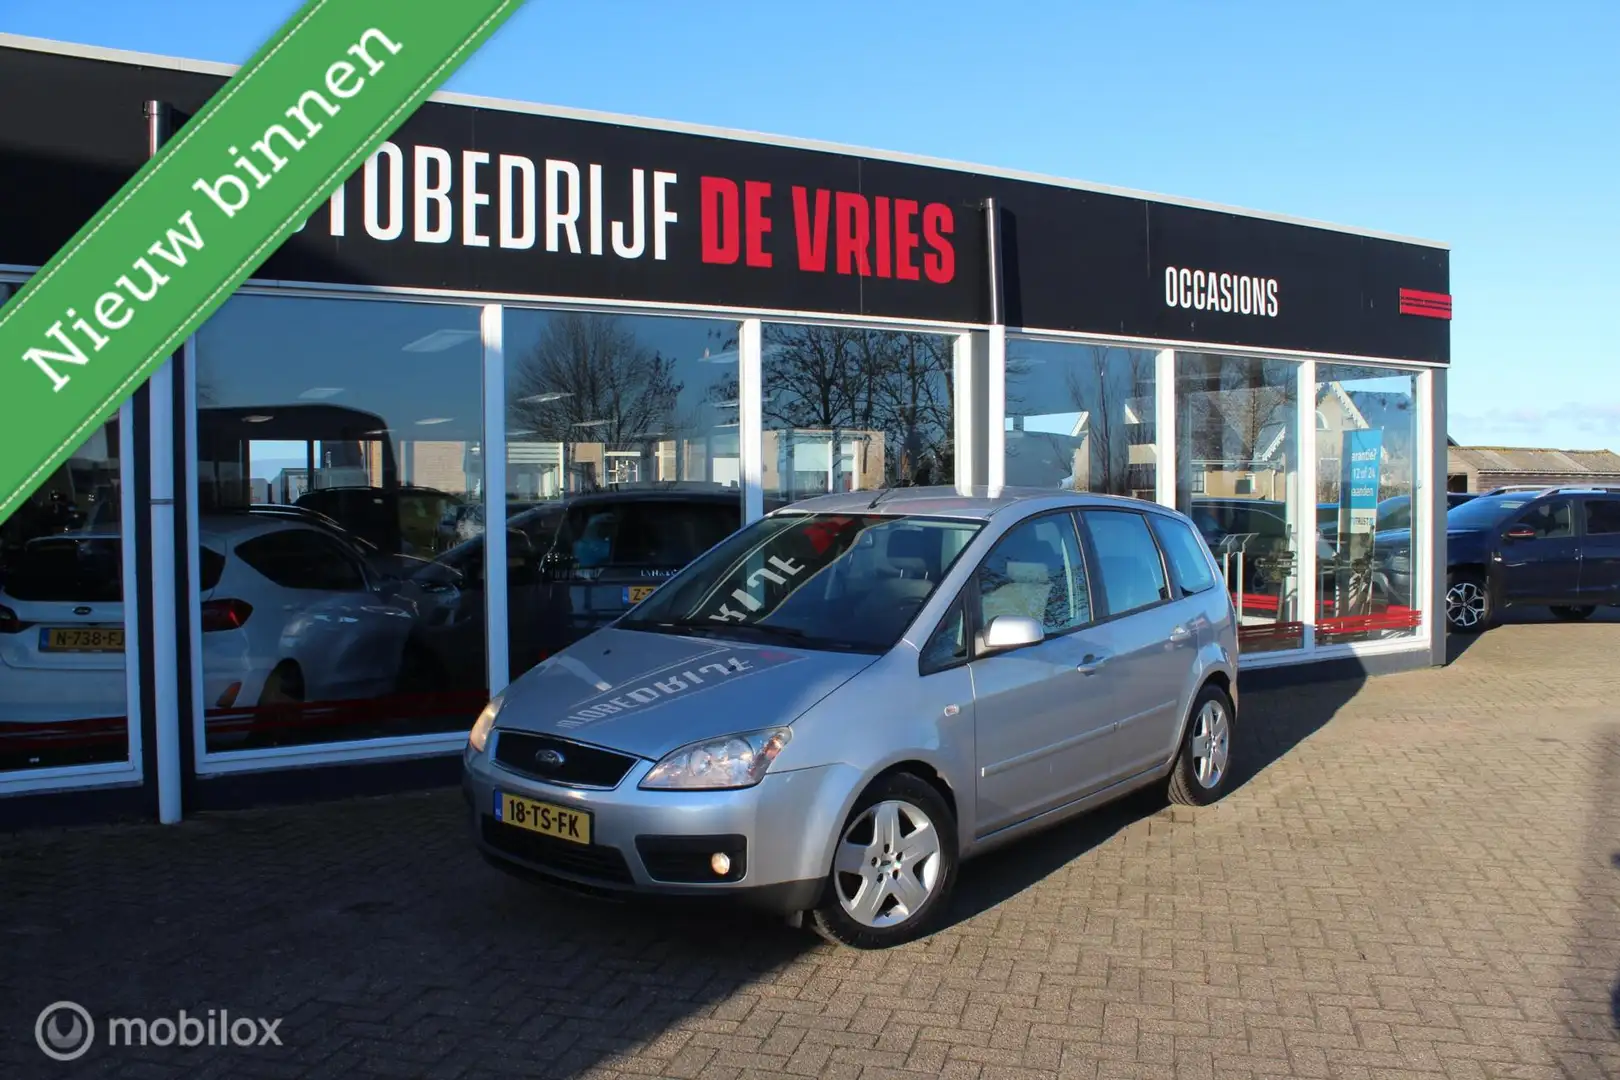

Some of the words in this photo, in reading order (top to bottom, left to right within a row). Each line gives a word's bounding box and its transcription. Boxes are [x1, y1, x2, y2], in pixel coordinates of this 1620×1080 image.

[294, 141, 678, 261] TOBEDRIJF
[700, 175, 773, 268] DE
[791, 185, 956, 284] VRIES
[1165, 266, 1279, 318] OCCASIONS
[508, 798, 580, 838] 18-TS-FK
